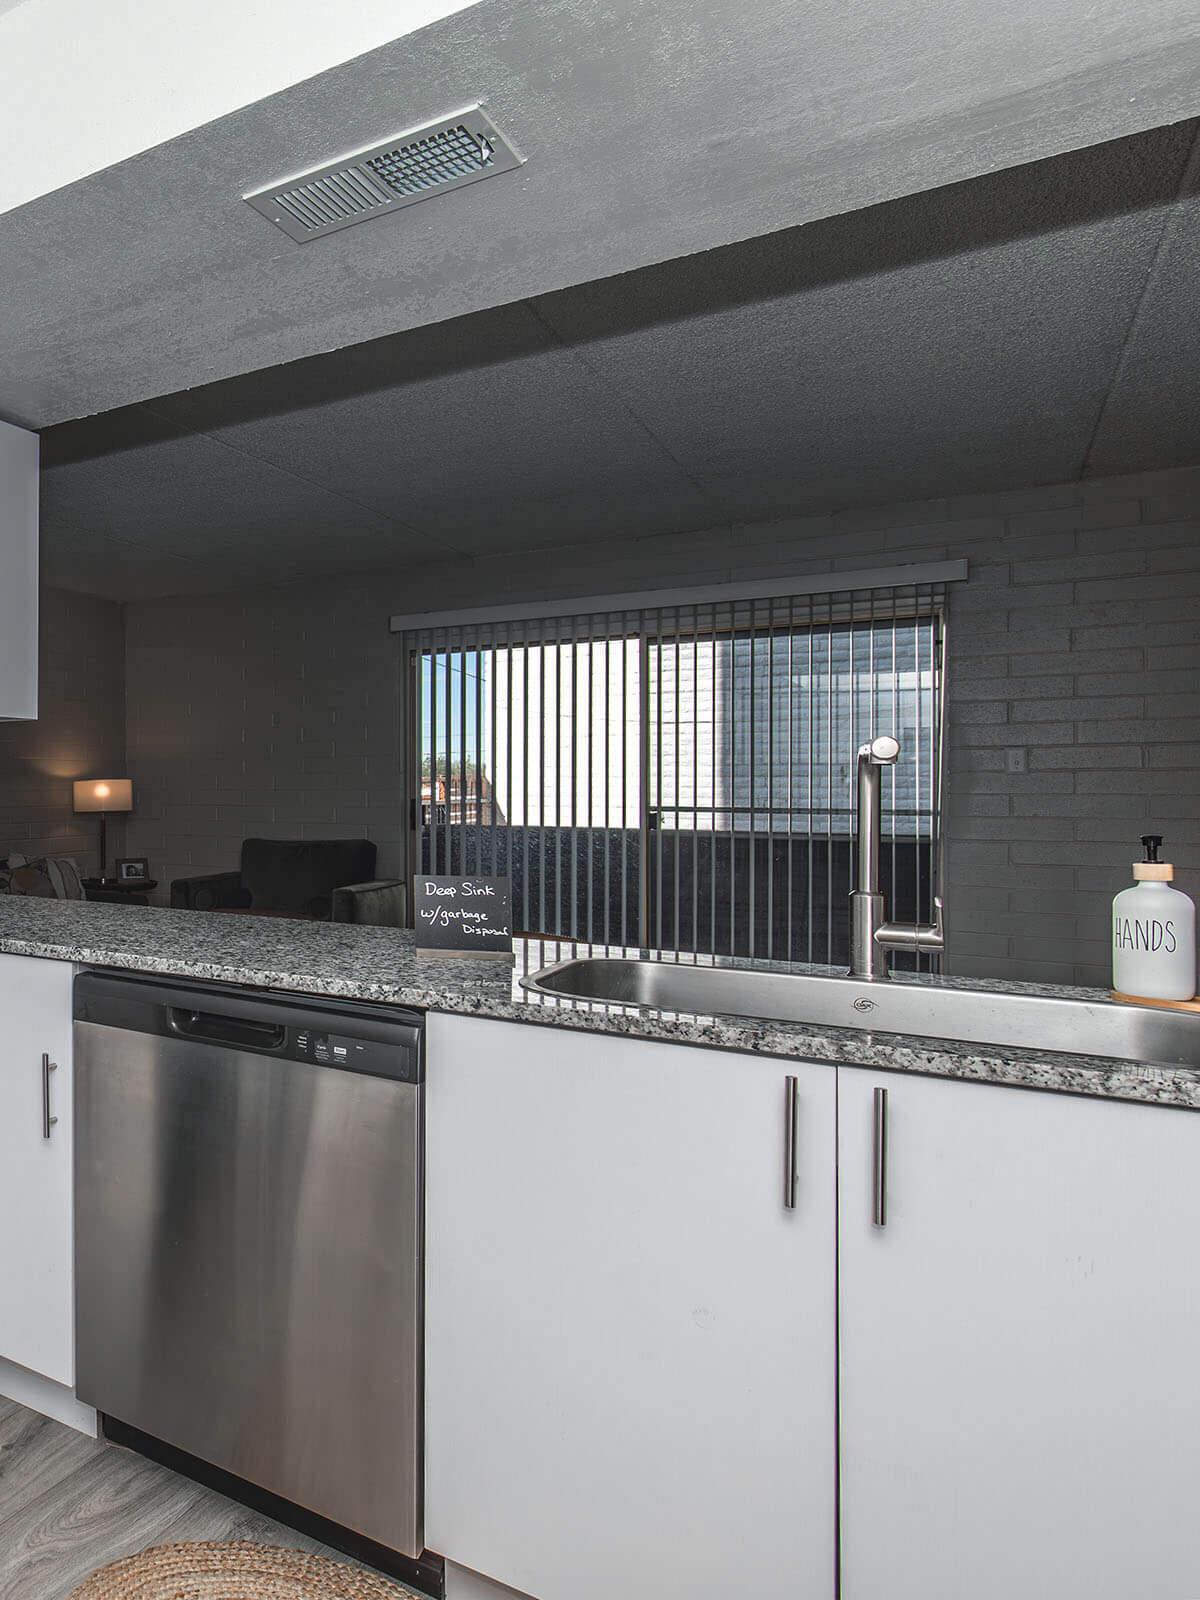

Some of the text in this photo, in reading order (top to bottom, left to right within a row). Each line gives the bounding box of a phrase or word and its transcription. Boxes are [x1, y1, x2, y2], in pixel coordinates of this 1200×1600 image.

[425, 882, 495, 898] Deep Sink
[420, 905, 488, 926] w/garbage
[1115, 917, 1177, 953] HANDS
